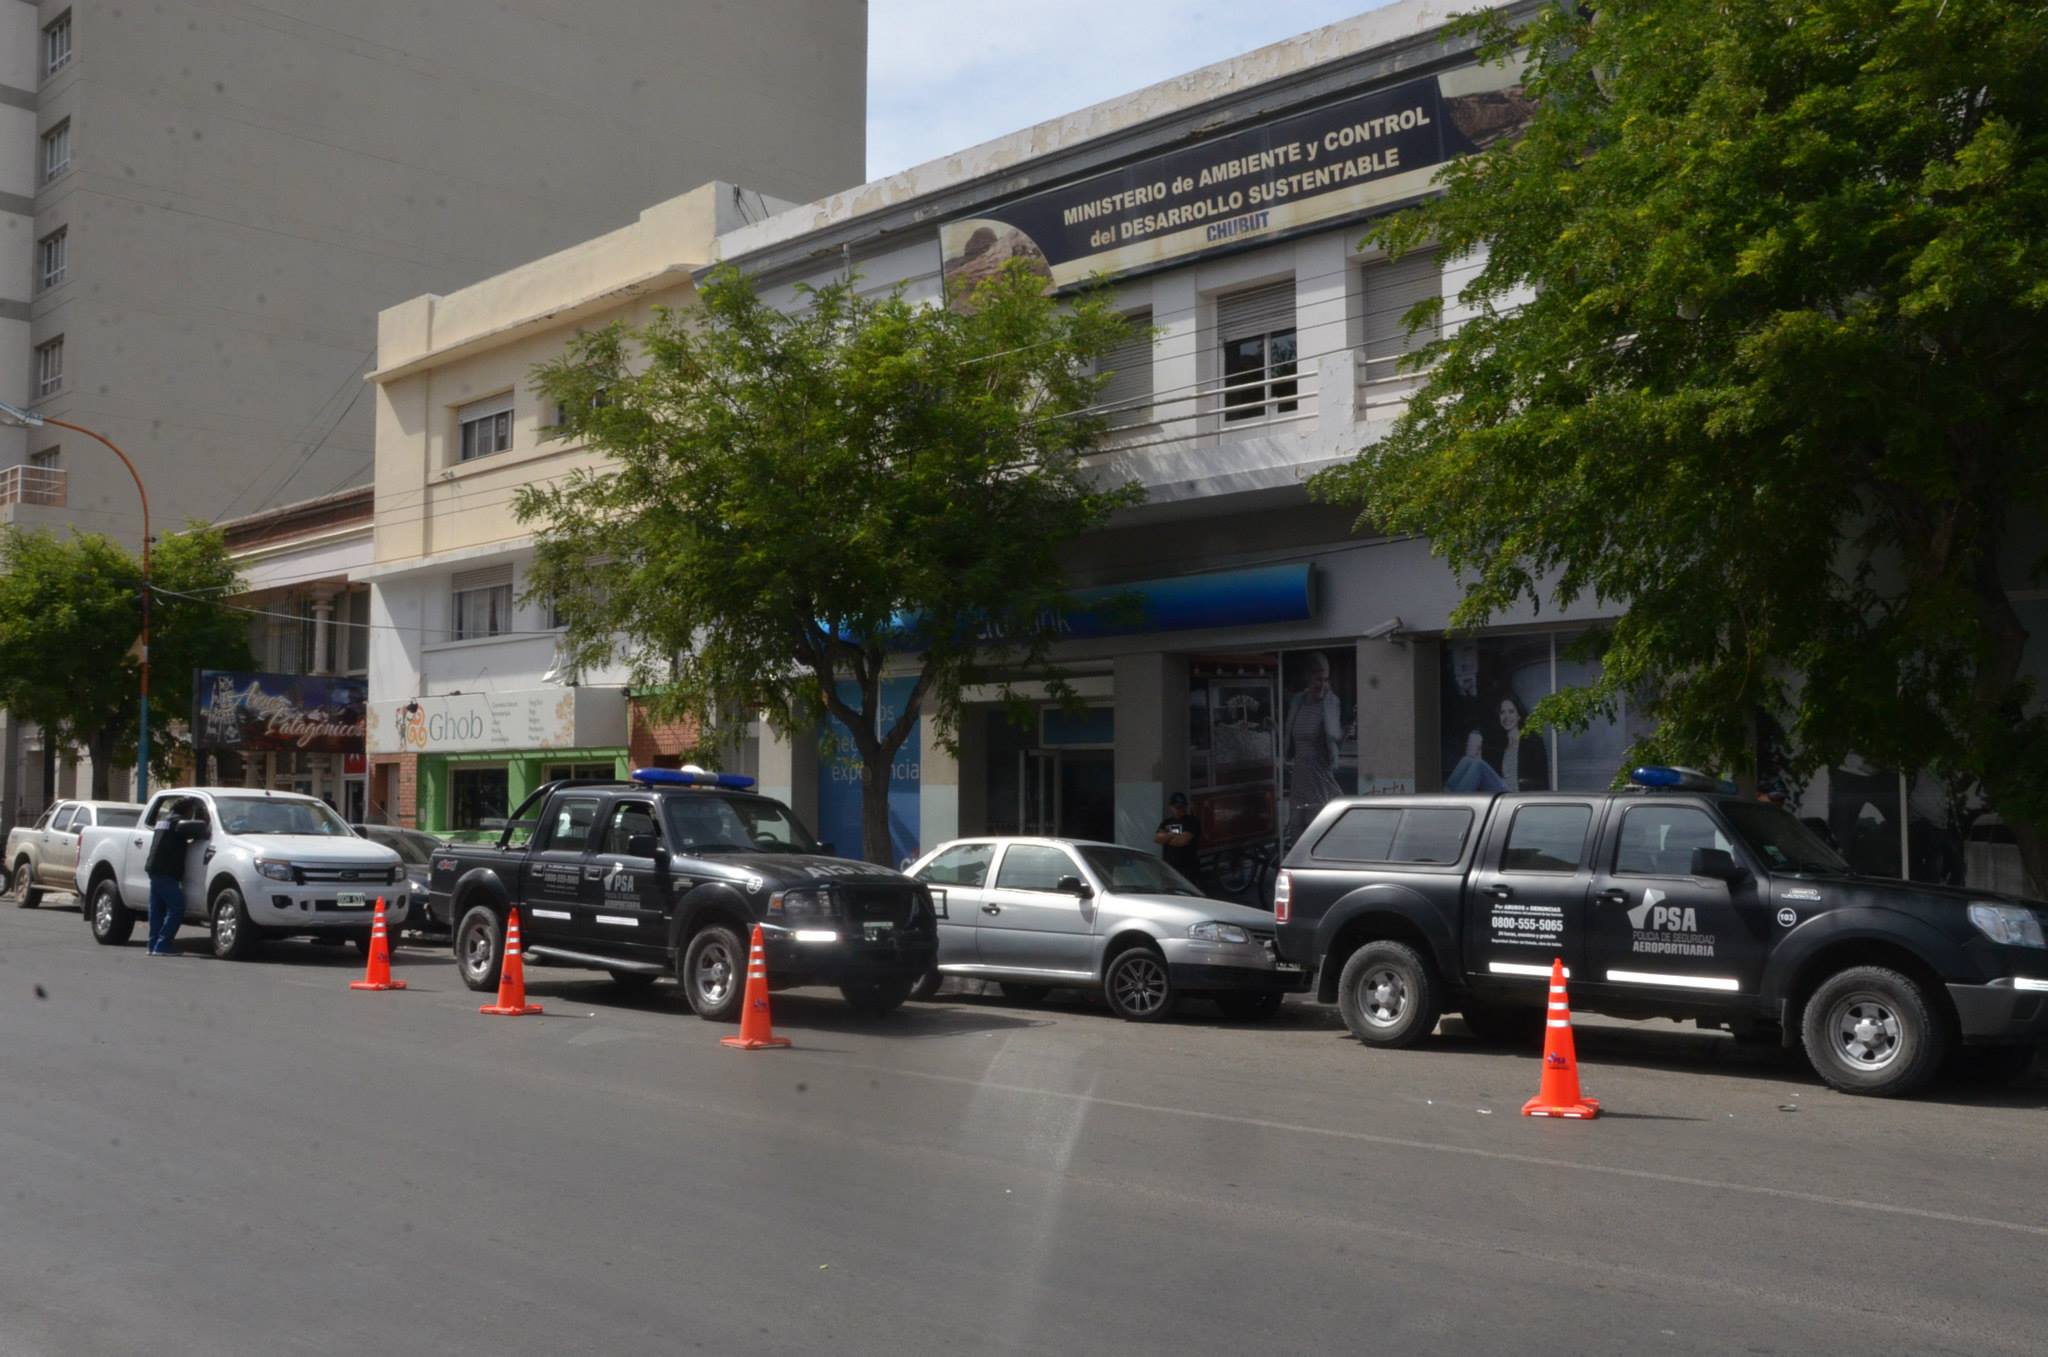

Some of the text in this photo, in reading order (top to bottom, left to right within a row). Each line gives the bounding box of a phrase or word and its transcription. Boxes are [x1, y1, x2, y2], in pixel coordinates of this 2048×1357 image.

[1064, 106, 1431, 225] MINISTERIO de AMBIENTE y CONTROL
[1090, 148, 1400, 248] del DESARROLLO SUSTENTABLE
[1206, 211, 1271, 243] CHUBUT
[428, 710, 484, 742] Ghob
[614, 875, 635, 892] PSA
[1491, 916, 1564, 932] 0800-555-5065
[1653, 906, 1697, 932] PSA
[1632, 941, 1715, 957] AEROPORTUARIA
[1661, 932, 1671, 942] DE
[1672, 932, 1715, 944] SEGURIDAD
